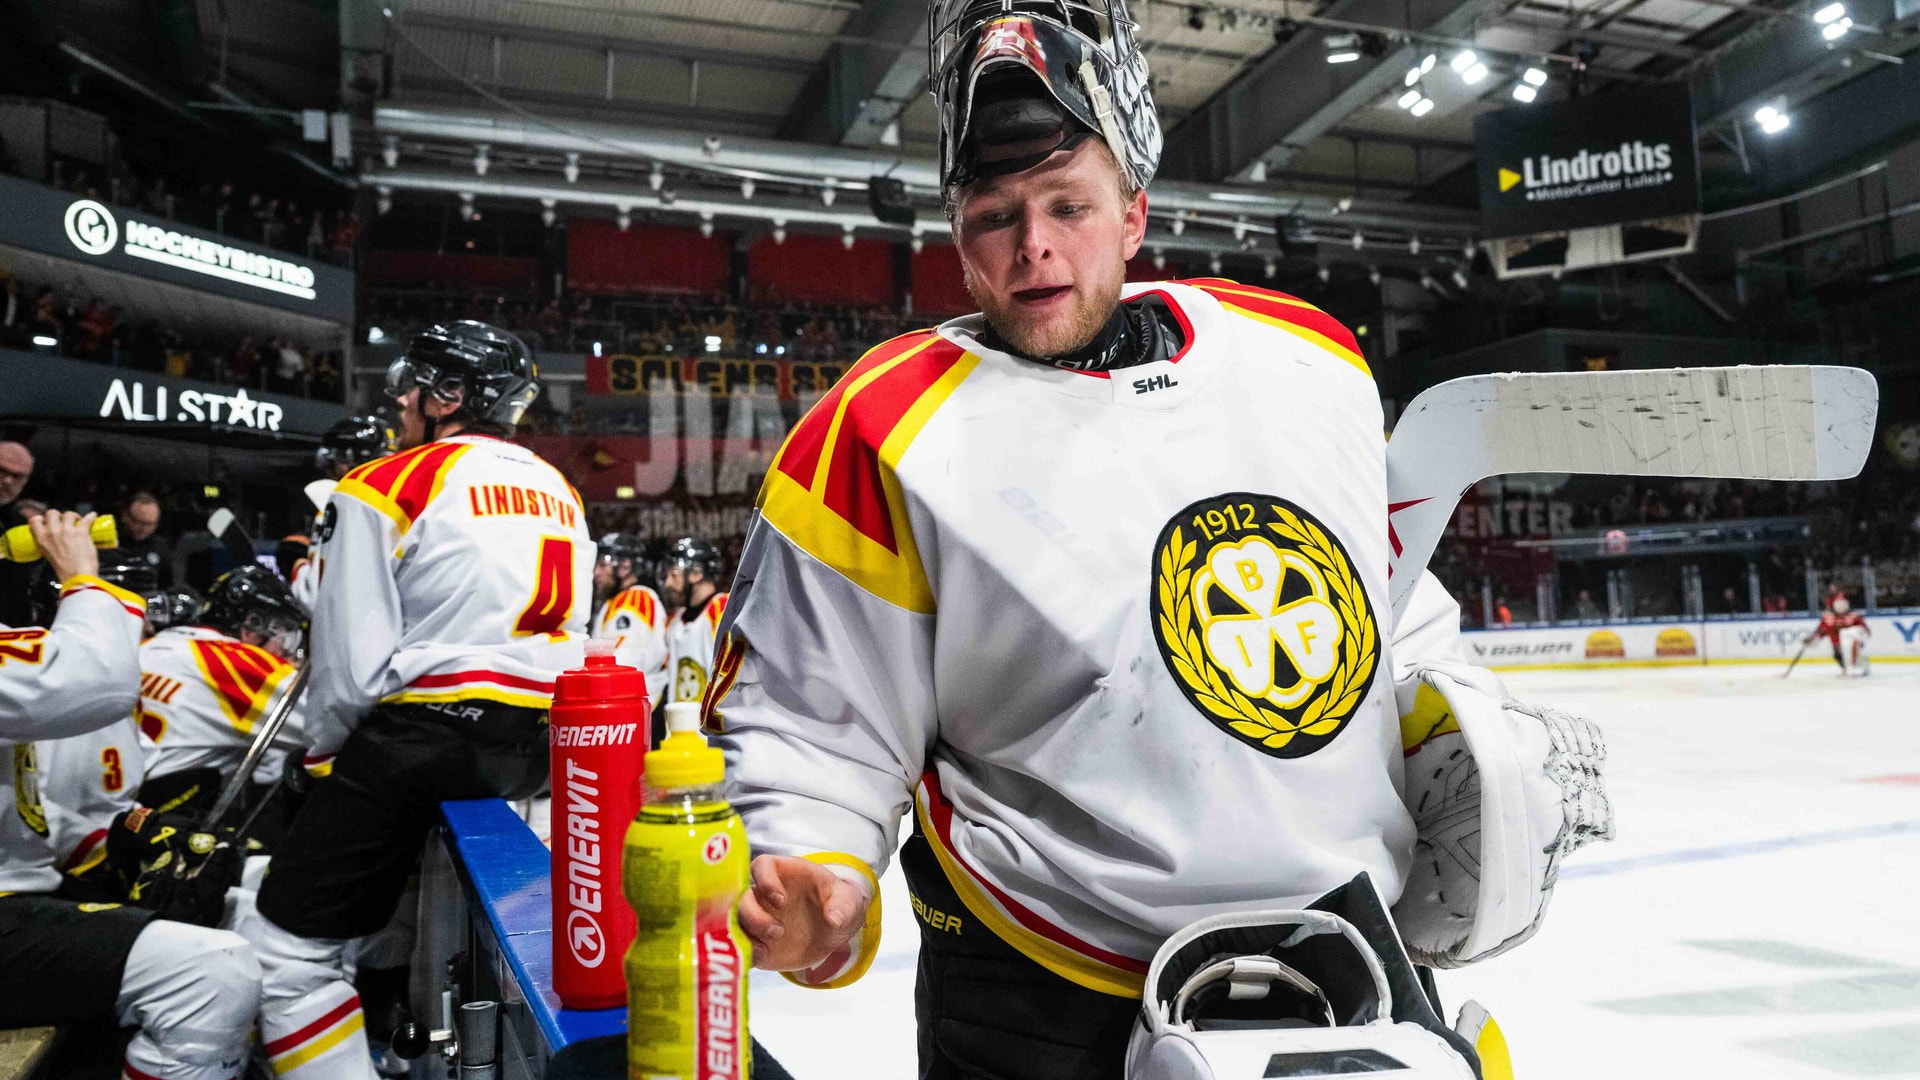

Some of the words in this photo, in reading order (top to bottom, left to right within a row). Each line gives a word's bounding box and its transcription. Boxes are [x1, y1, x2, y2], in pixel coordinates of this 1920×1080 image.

[1522, 140, 1672, 189] Lindroths
[126, 219, 315, 289] HOCKEYBISTRO
[1132, 374, 1179, 395] SHL
[1192, 503, 1260, 541] 1912
[1456, 500, 1576, 538] ENTER
[512, 534, 576, 644] 4
[1234, 559, 1265, 593] B
[1233, 634, 1253, 668] I
[1295, 619, 1318, 656] F
[556, 722, 637, 747] ENERVIT
[100, 746, 124, 793] 3
[566, 757, 602, 914] ENERVIT
[704, 931, 736, 1076] ENERVIT
